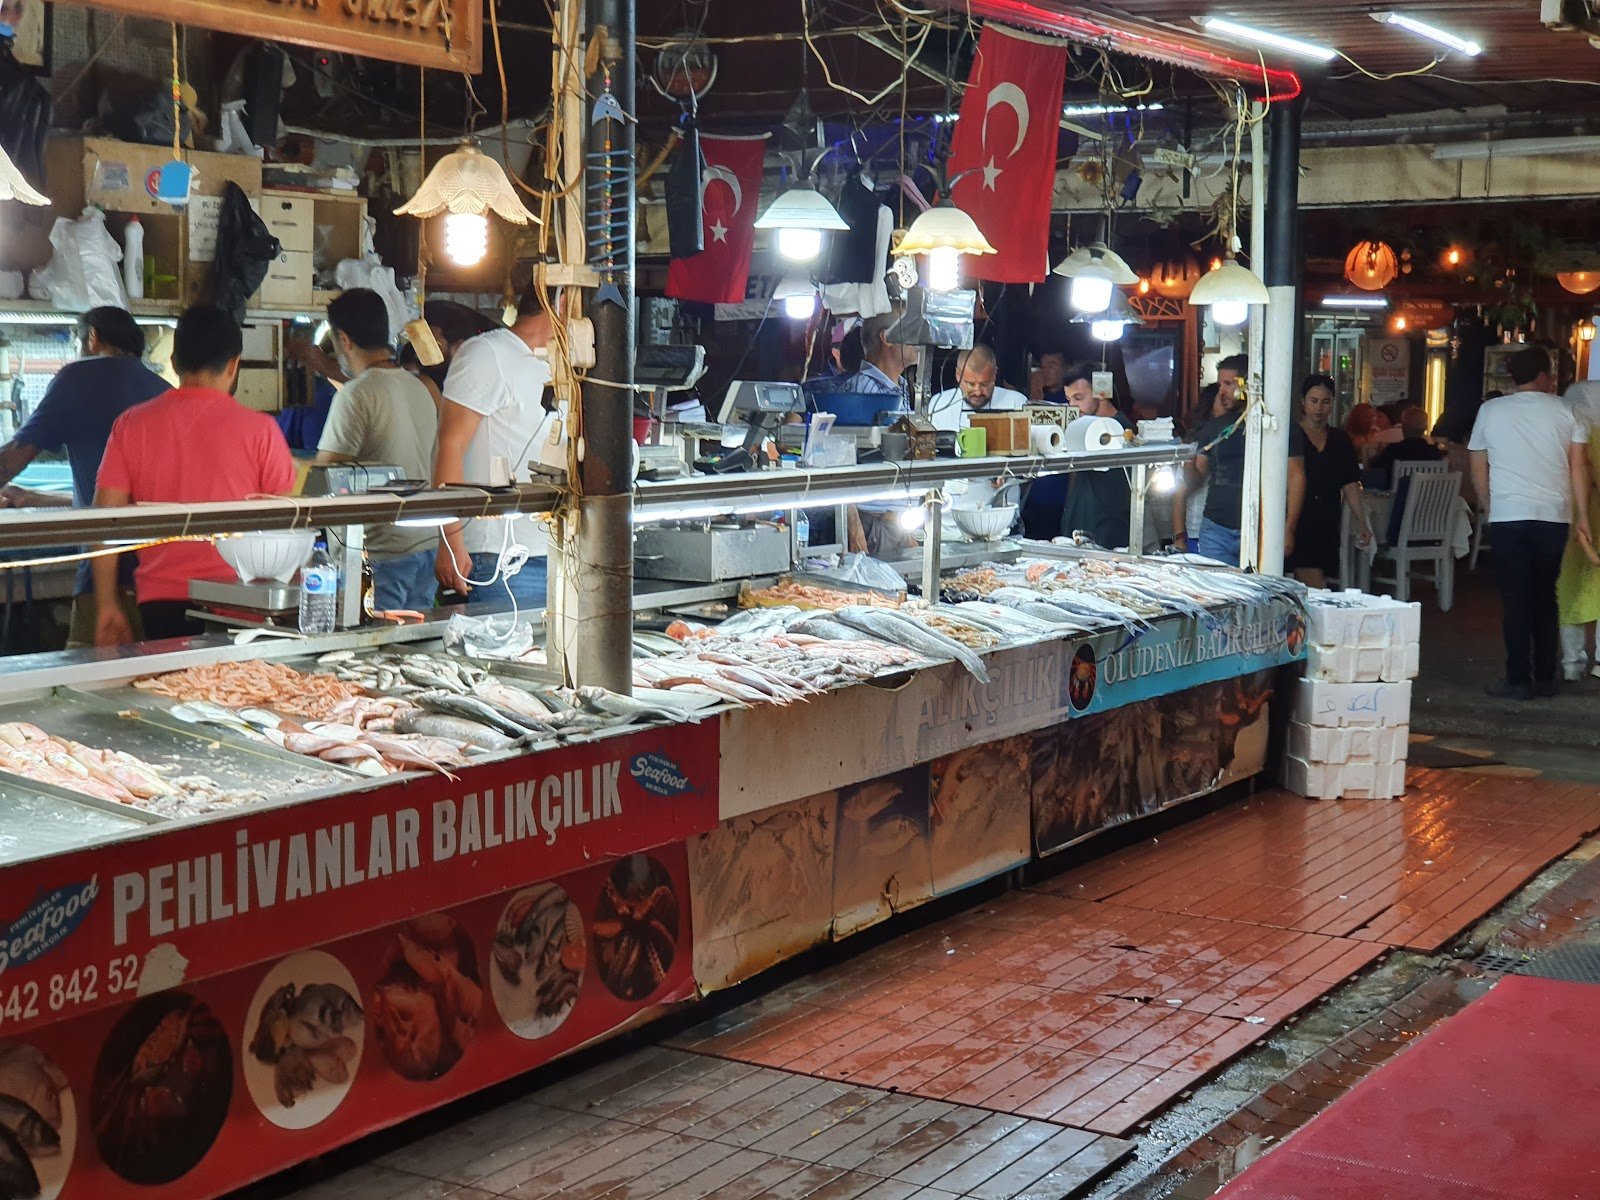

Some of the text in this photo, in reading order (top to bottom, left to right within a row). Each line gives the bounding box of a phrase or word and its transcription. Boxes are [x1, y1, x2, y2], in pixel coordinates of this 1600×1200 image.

[898, 655, 1055, 732] ALIKÇILIK
[631, 757, 688, 789] Seafood
[113, 761, 623, 946] PEHLİVANLAR BALIKÇILIK
[0, 873, 99, 975] eafood
[50, 964, 98, 1011] 842
[108, 954, 138, 994] 52
